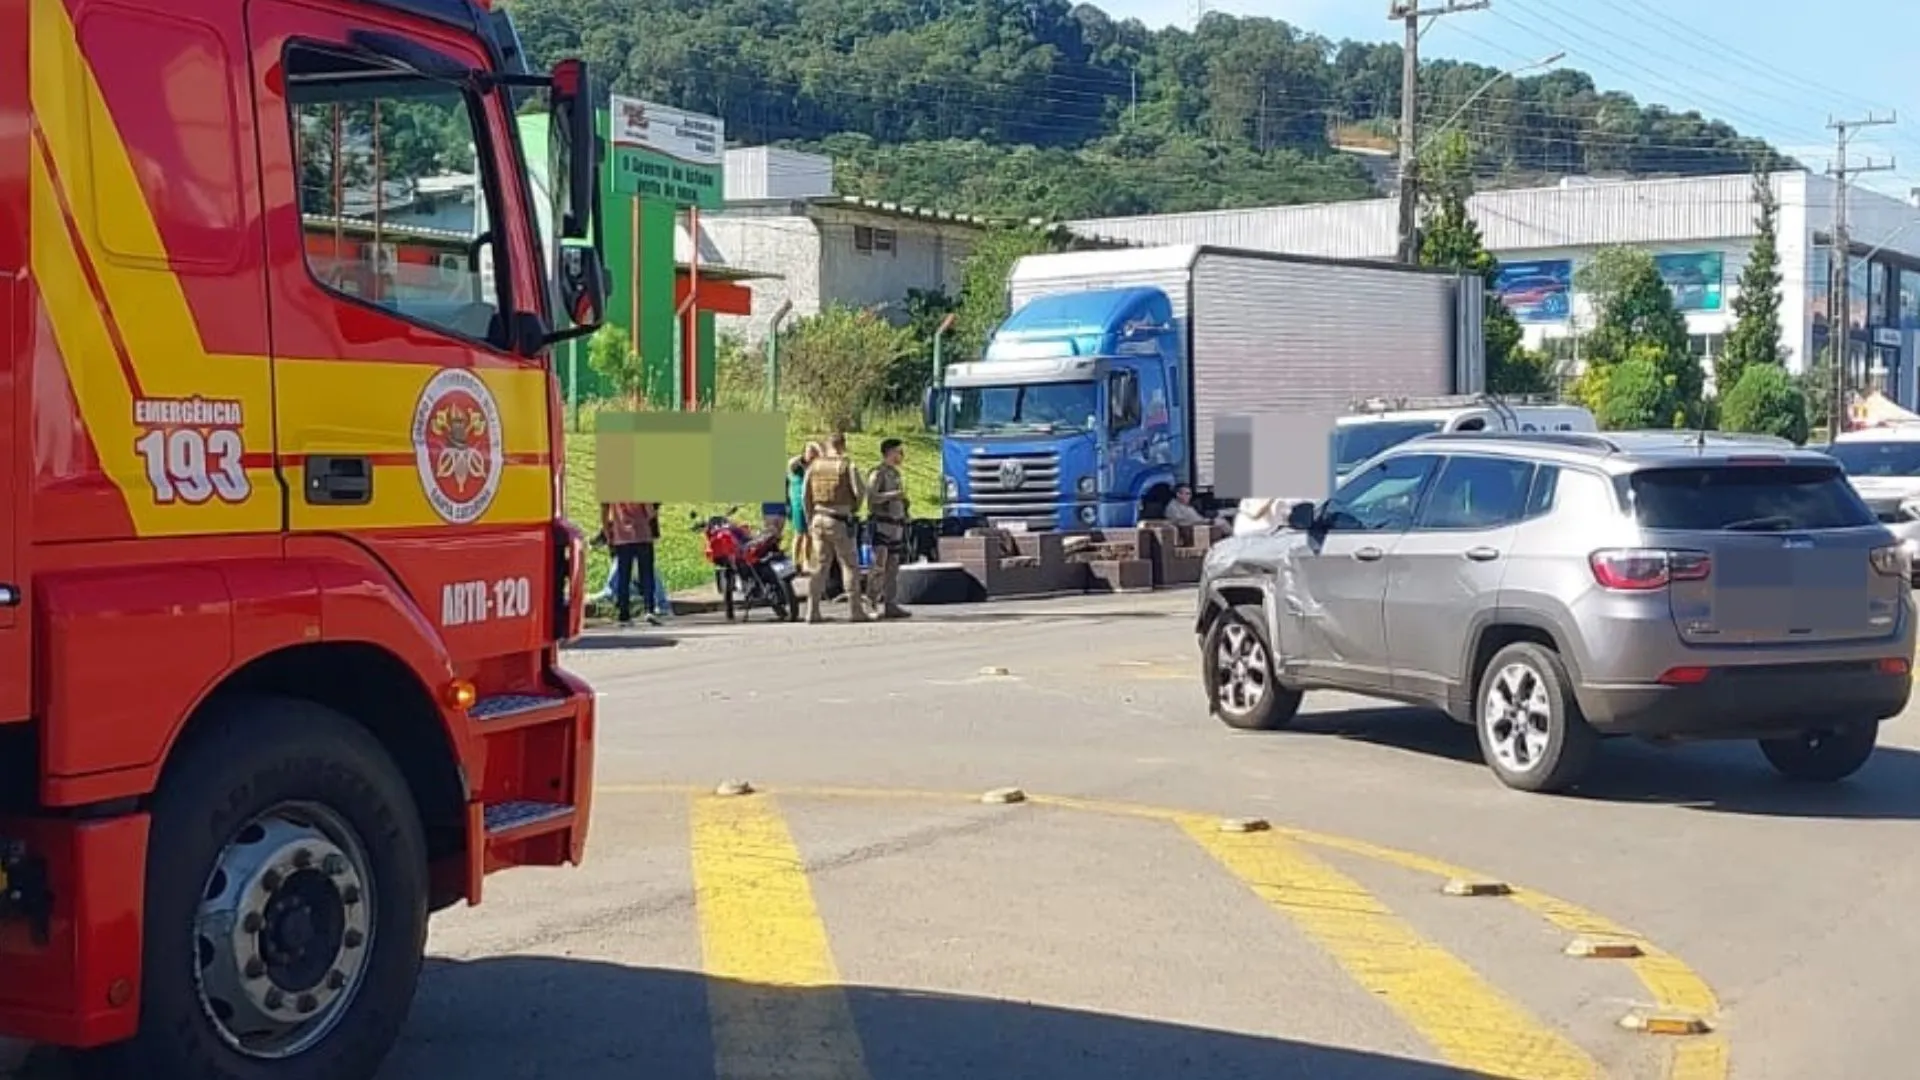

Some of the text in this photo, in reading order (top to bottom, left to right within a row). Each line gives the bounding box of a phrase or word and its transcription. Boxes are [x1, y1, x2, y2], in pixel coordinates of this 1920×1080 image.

[135, 397, 241, 425] EMERGÊNCIA
[136, 429, 250, 501] 193
[441, 576, 530, 627] ABTR-120
